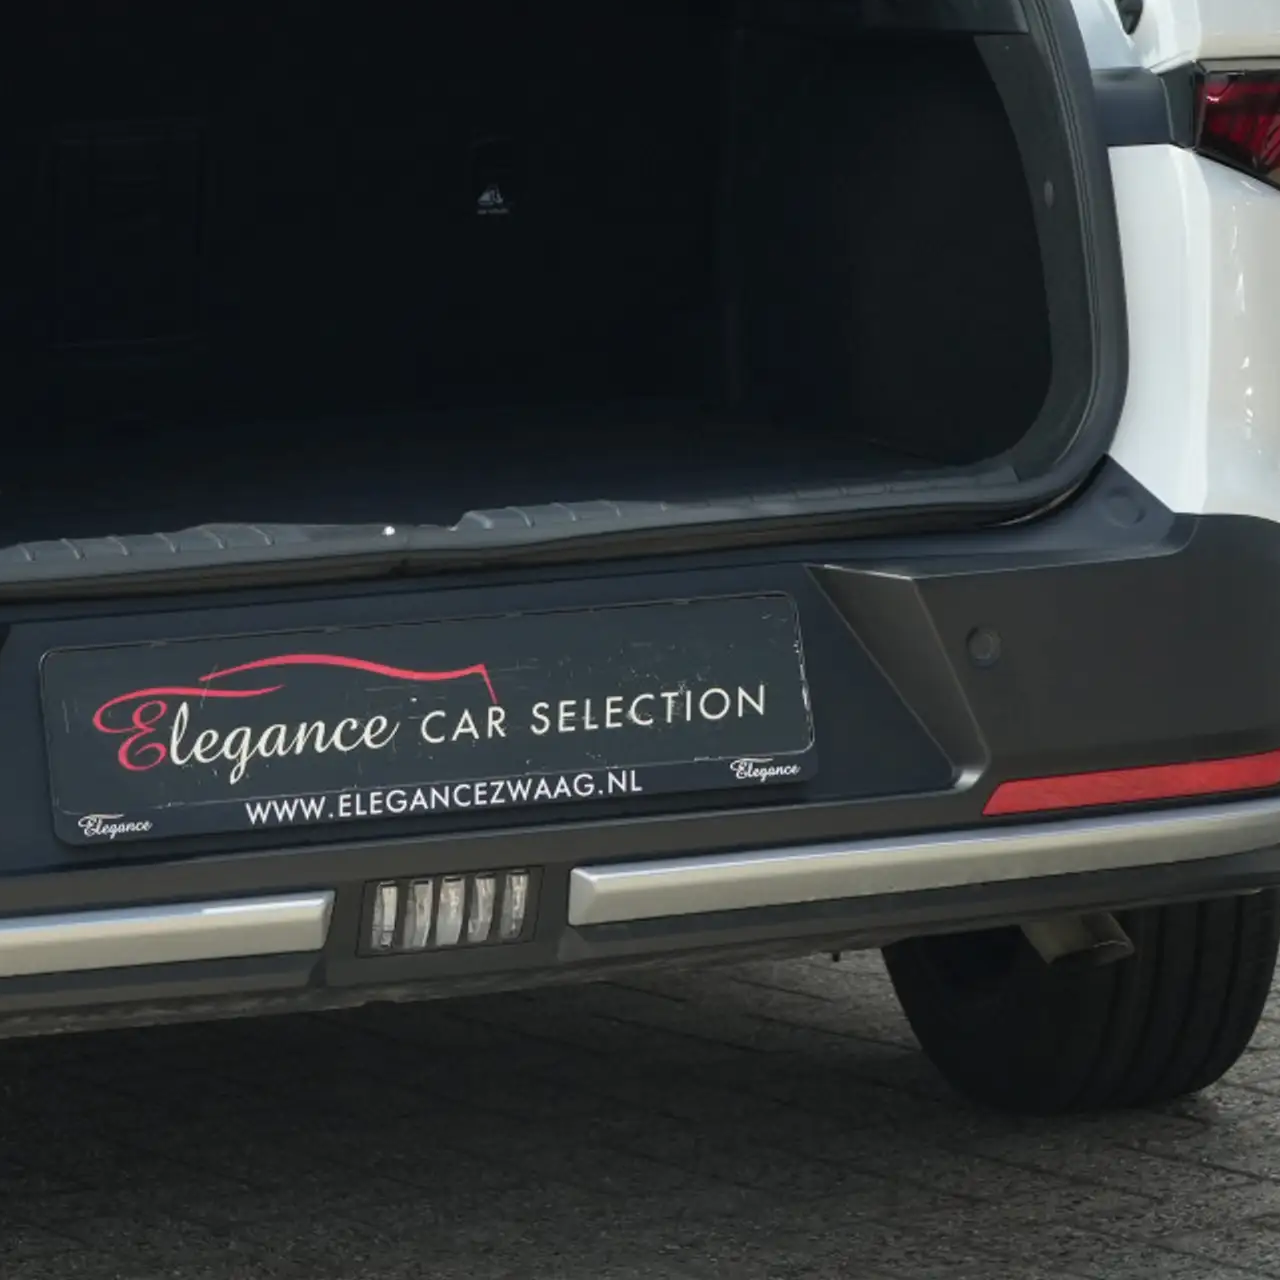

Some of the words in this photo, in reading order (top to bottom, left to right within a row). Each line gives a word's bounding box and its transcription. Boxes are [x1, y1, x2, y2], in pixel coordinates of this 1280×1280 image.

[92, 687, 401, 786] Elegance
[420, 704, 506, 745] CAR
[530, 683, 766, 736] SELECTION
[730, 757, 801, 784] Elegance
[244, 769, 643, 826] WWW.ELEGANCEZWAAG.NL
[77, 813, 153, 840] Elegance
